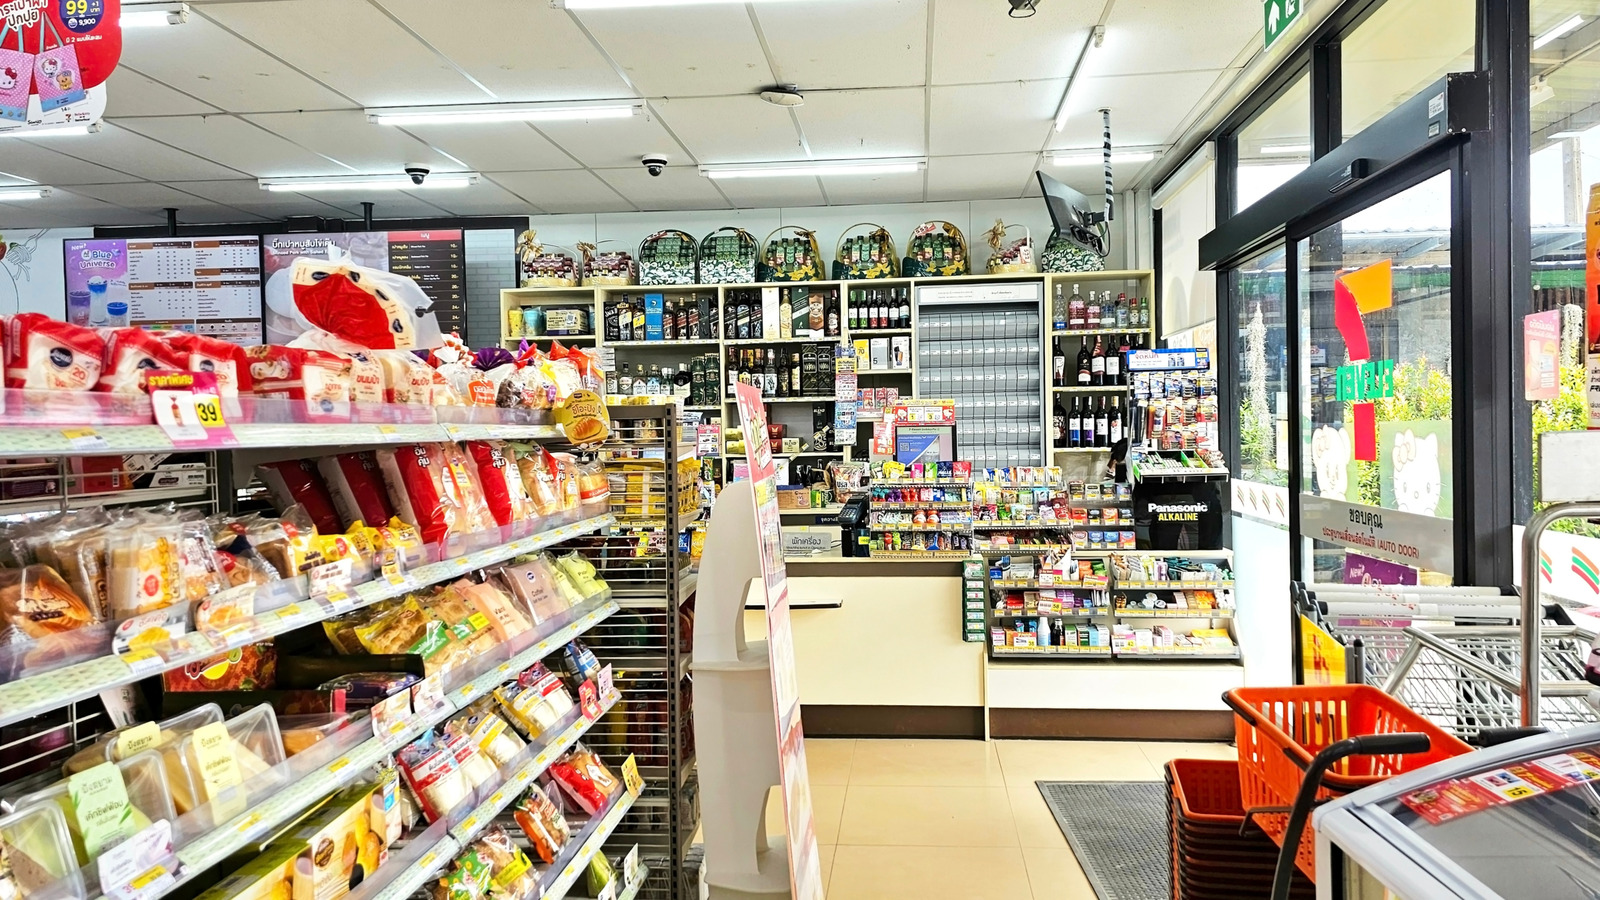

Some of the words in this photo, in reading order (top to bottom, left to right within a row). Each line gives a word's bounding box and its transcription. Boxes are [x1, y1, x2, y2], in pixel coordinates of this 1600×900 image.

[66, 0, 87, 15] 99
[78, 18, 96, 26] 9,900
[80, 261, 115, 269] Universe
[72, 367, 86, 380] 20
[149, 373, 193, 386] ราคาพิเศษ
[198, 402, 218, 422] 39
[1147, 503, 1208, 512] Panasonic
[1158, 513, 1198, 521] ALKALINE
[1349, 508, 1383, 534] ขอบคุณ
[791, 536, 821, 546] พักเครื่อง
[1377, 540, 1396, 553] (AUTO
[1398, 543, 1419, 559] DOOR)
[1507, 787, 1528, 796] 15
